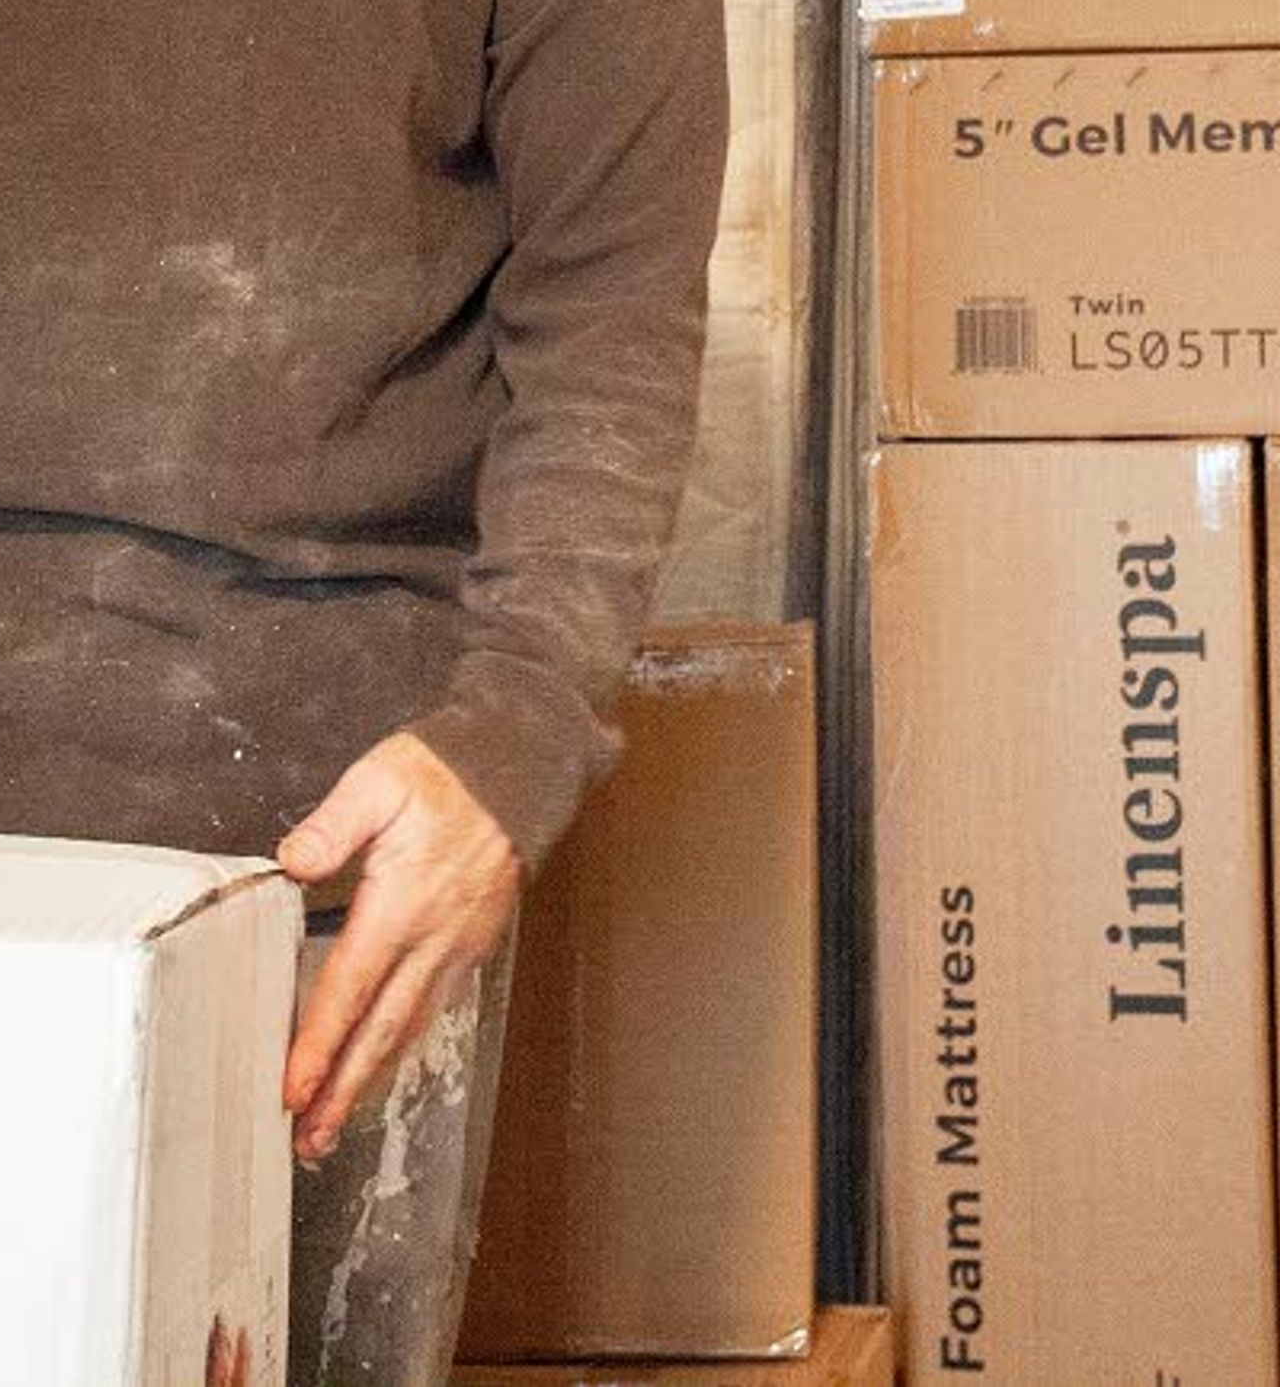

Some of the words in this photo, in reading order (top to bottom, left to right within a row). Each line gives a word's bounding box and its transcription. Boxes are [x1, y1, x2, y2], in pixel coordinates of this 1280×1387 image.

[1032, 113, 1125, 157] Gel
[1070, 293, 1145, 315] Twin
[1107, 535, 1206, 1024] Linenspa
[935, 886, 979, 1166] Mattress
[940, 1190, 985, 1373] Foam
